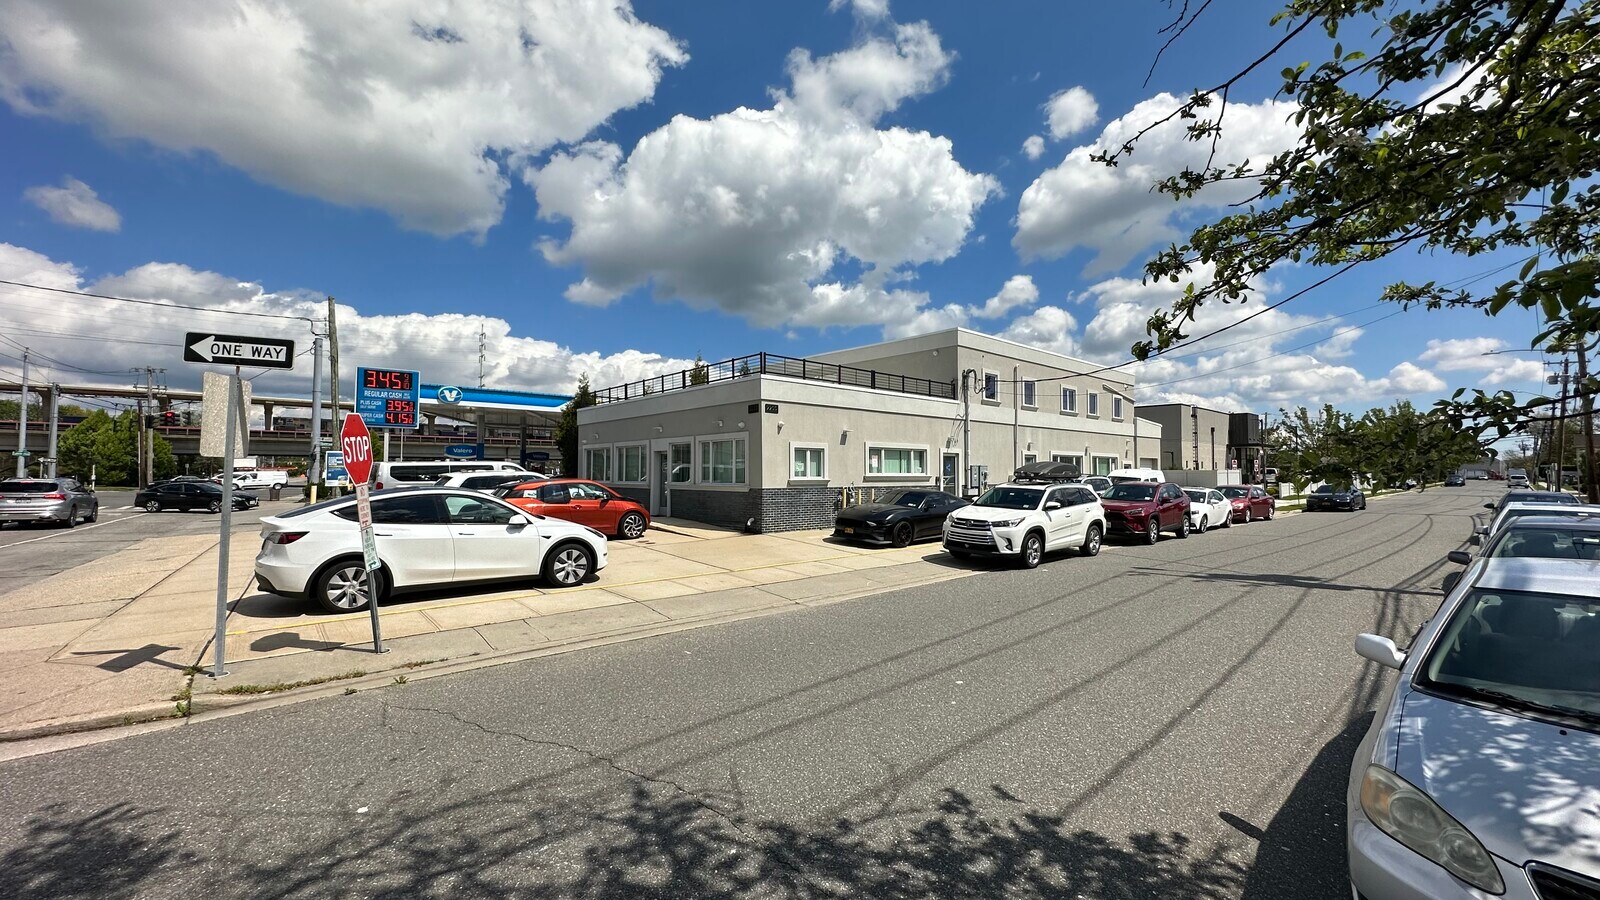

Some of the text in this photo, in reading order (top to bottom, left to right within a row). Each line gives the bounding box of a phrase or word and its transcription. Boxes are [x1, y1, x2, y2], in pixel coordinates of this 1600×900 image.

[210, 343, 284, 359] ONE WAY
[364, 390, 388, 398] REGULAR
[344, 436, 369, 464] STOP
